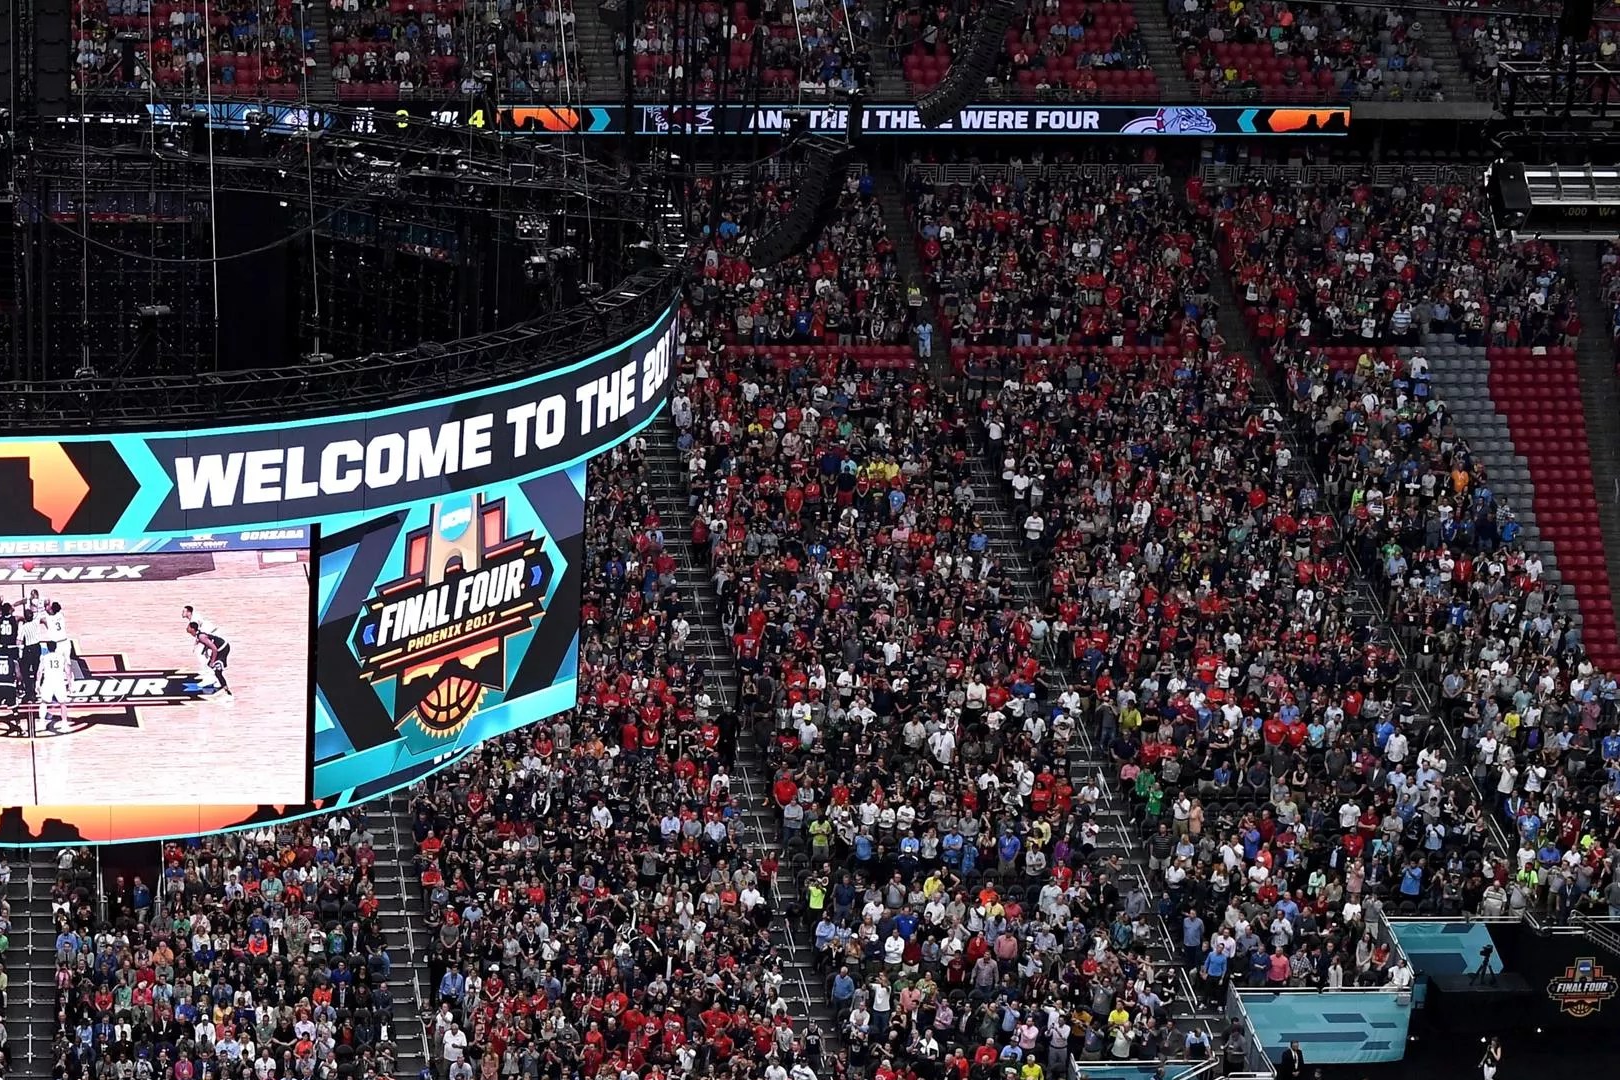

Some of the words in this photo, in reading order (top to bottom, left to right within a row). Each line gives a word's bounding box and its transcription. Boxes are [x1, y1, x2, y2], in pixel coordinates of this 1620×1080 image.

[468, 109, 486, 127] 4
[748, 110, 796, 129] AN
[809, 110, 869, 129] THE
[875, 110, 953, 129] THE
[960, 110, 1029, 129] WERE
[1035, 110, 1100, 129] FOUR
[175, 413, 492, 511] WELCOME
[505, 394, 567, 459] TO
[575, 360, 637, 436] THE
[64, 538, 126, 553] FOUR
[376, 584, 450, 647] FINAL
[454, 558, 526, 621] FOUR
[55, 621, 62, 632] 3
[407, 623, 463, 652] PHOENIX
[465, 612, 496, 632] 2017
[48, 659, 60, 670] 13
[70, 679, 169, 698] OUR
[1556, 982, 1582, 993] FINAL
[1583, 981, 1608, 992] FOUR
